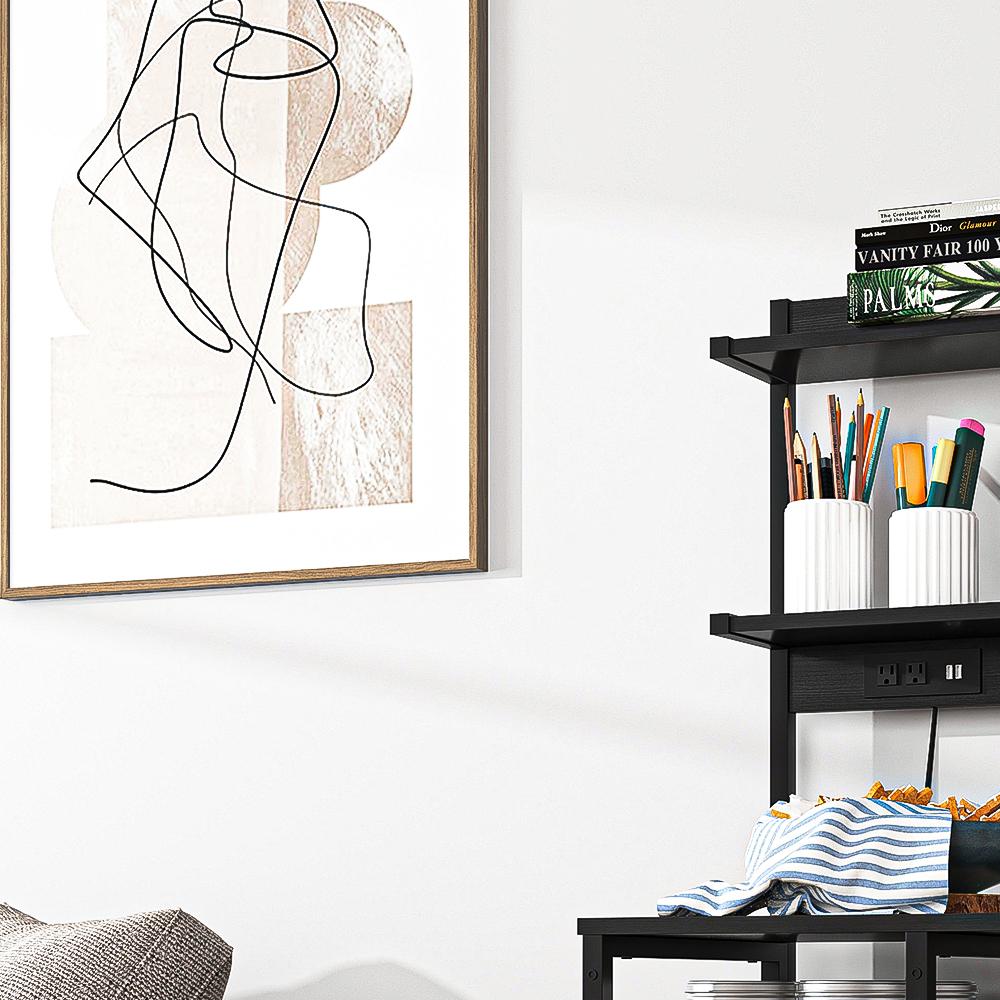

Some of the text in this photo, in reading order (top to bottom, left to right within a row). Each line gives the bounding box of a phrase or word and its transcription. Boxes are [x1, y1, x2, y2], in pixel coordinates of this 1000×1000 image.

[929, 219, 997, 234] Dior Glamour
[857, 246, 920, 265] VANITY
[923, 241, 962, 258] FAIR
[966, 238, 990, 255] 100
[863, 282, 937, 314] PALMS
